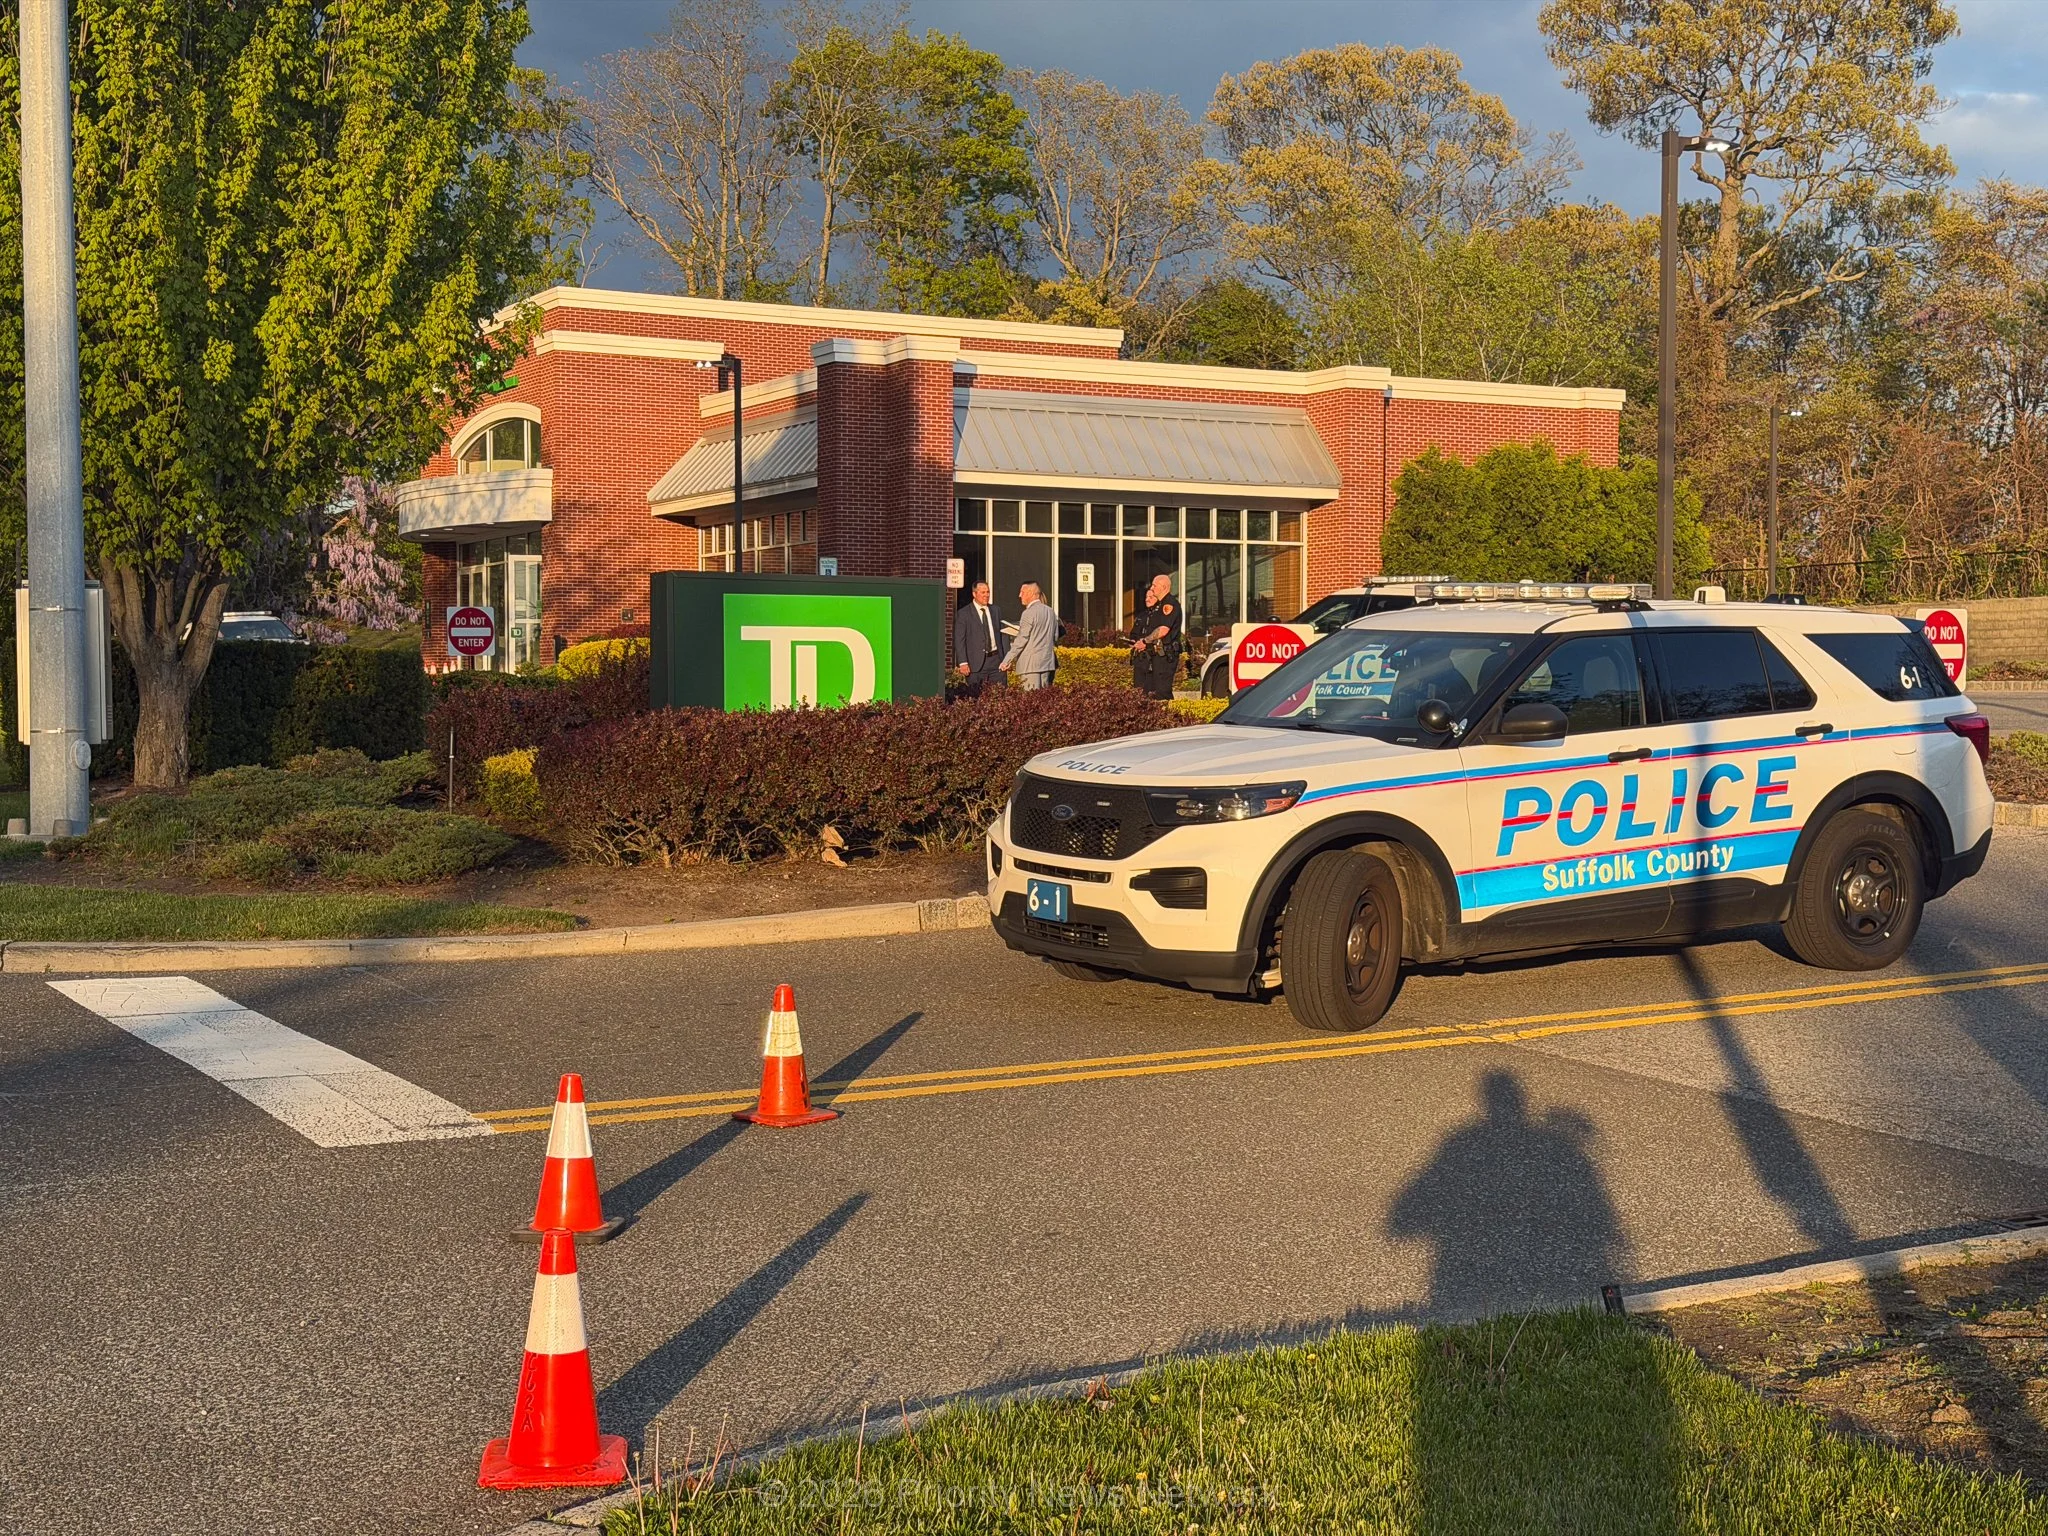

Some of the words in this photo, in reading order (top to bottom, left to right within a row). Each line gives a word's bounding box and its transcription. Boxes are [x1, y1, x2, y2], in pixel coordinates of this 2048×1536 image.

[455, 617, 467, 626] DO
[470, 617, 486, 626] NOT
[1940, 626, 1959, 640] NOT
[458, 638, 485, 647] ENTER
[1246, 643, 1265, 658] DO
[1271, 643, 1300, 659] NOT
[741, 625, 876, 712] TD
[1326, 654, 1396, 680] LICE
[1336, 684, 1372, 696] County
[1056, 760, 1131, 775] POLICE
[1495, 755, 1797, 858] POLICE
[1542, 854, 1636, 892] Suffolk
[1646, 843, 1735, 876] County
[1029, 885, 1061, 916] 6-1
